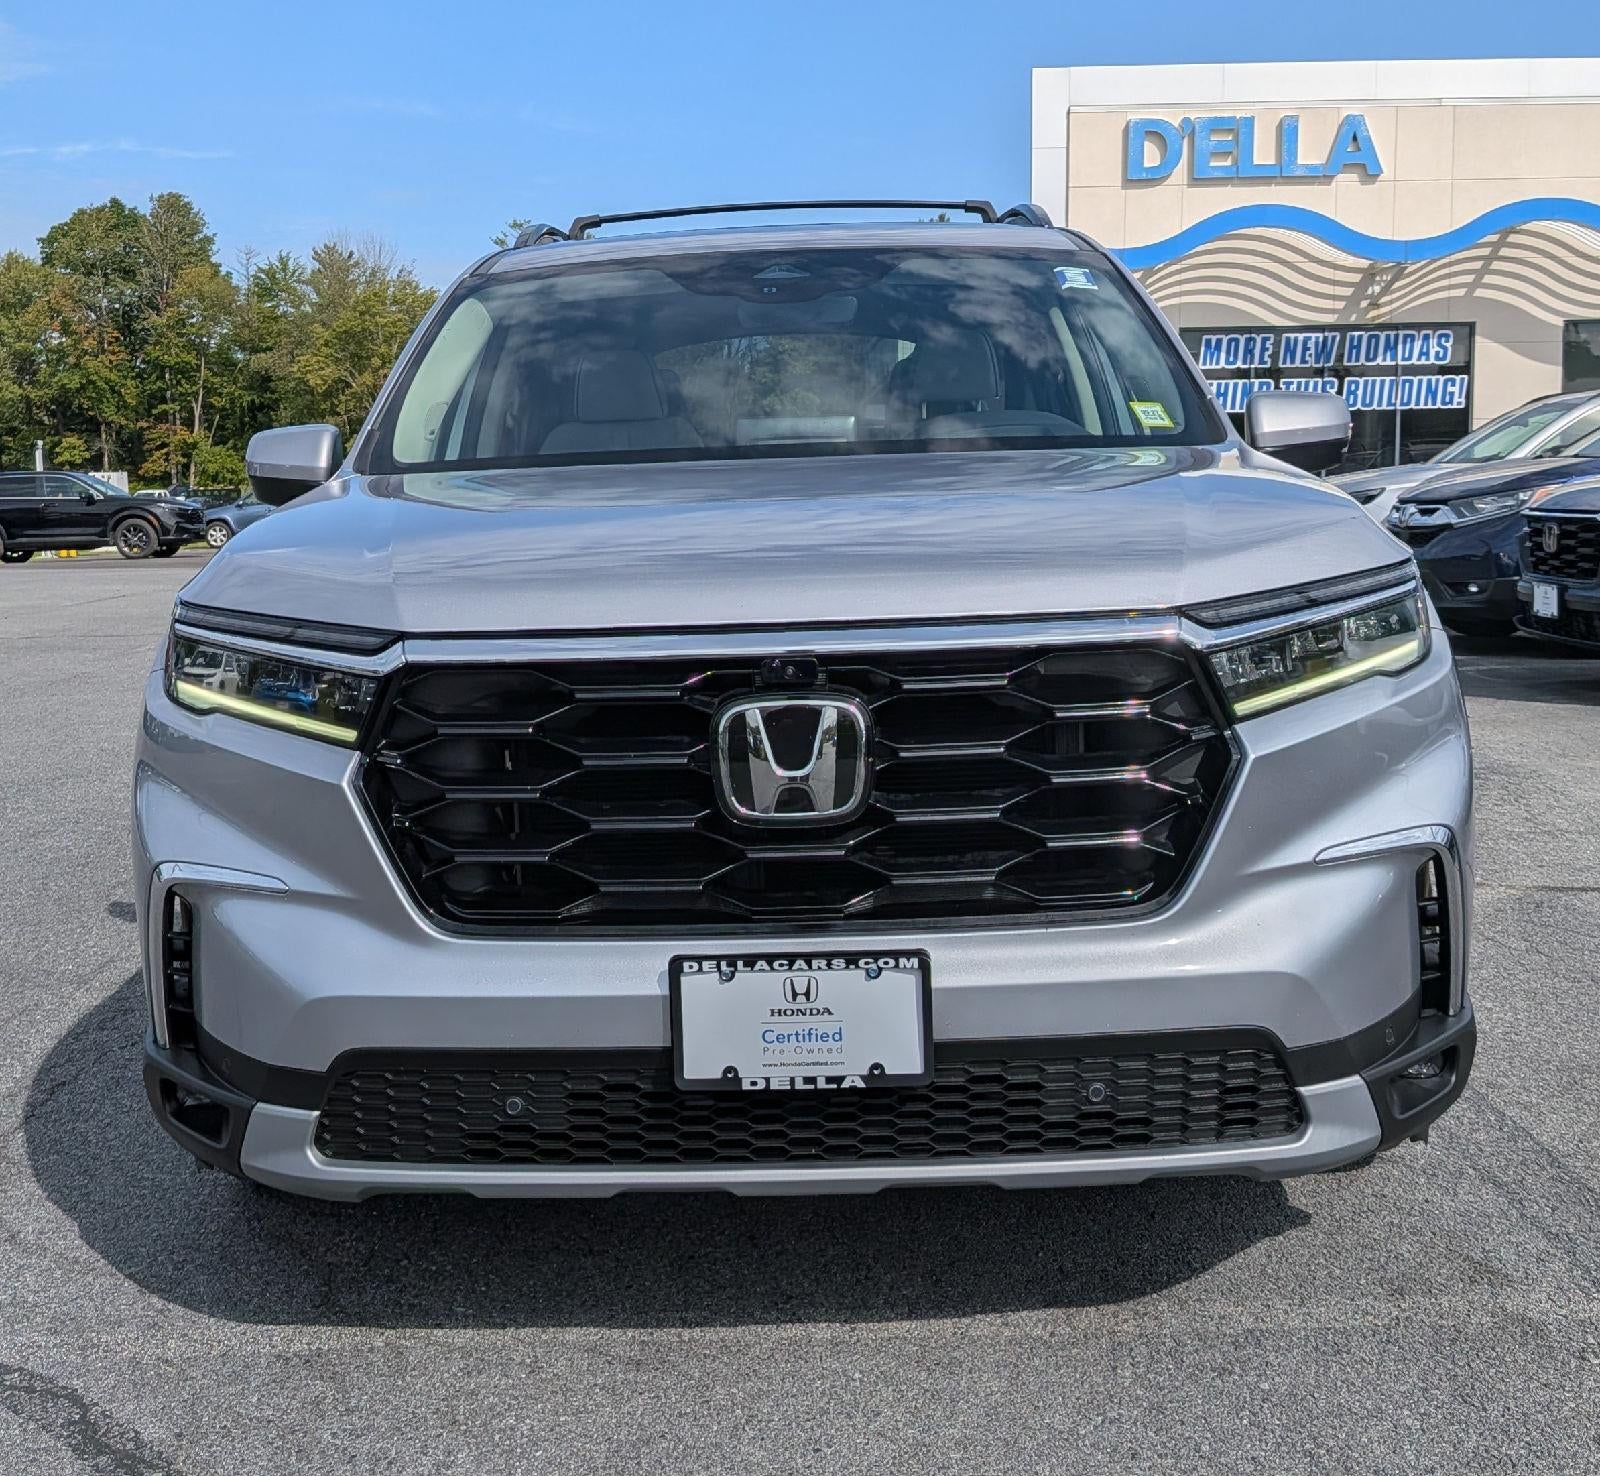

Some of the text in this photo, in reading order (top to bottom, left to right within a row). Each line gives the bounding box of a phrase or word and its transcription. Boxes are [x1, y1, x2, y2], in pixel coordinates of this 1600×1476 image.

[1127, 113, 1384, 180] D'ELLA
[1201, 331, 1453, 368] MORE NEW HONDAS
[1343, 375, 1469, 410] BUILDING!
[682, 957, 919, 973] DELLACARS.COM
[769, 1007, 834, 1017] HONDA
[762, 1027, 843, 1044] Certified
[763, 1044, 843, 1055] Pre-Owned
[742, 1076, 866, 1090] DELLA
